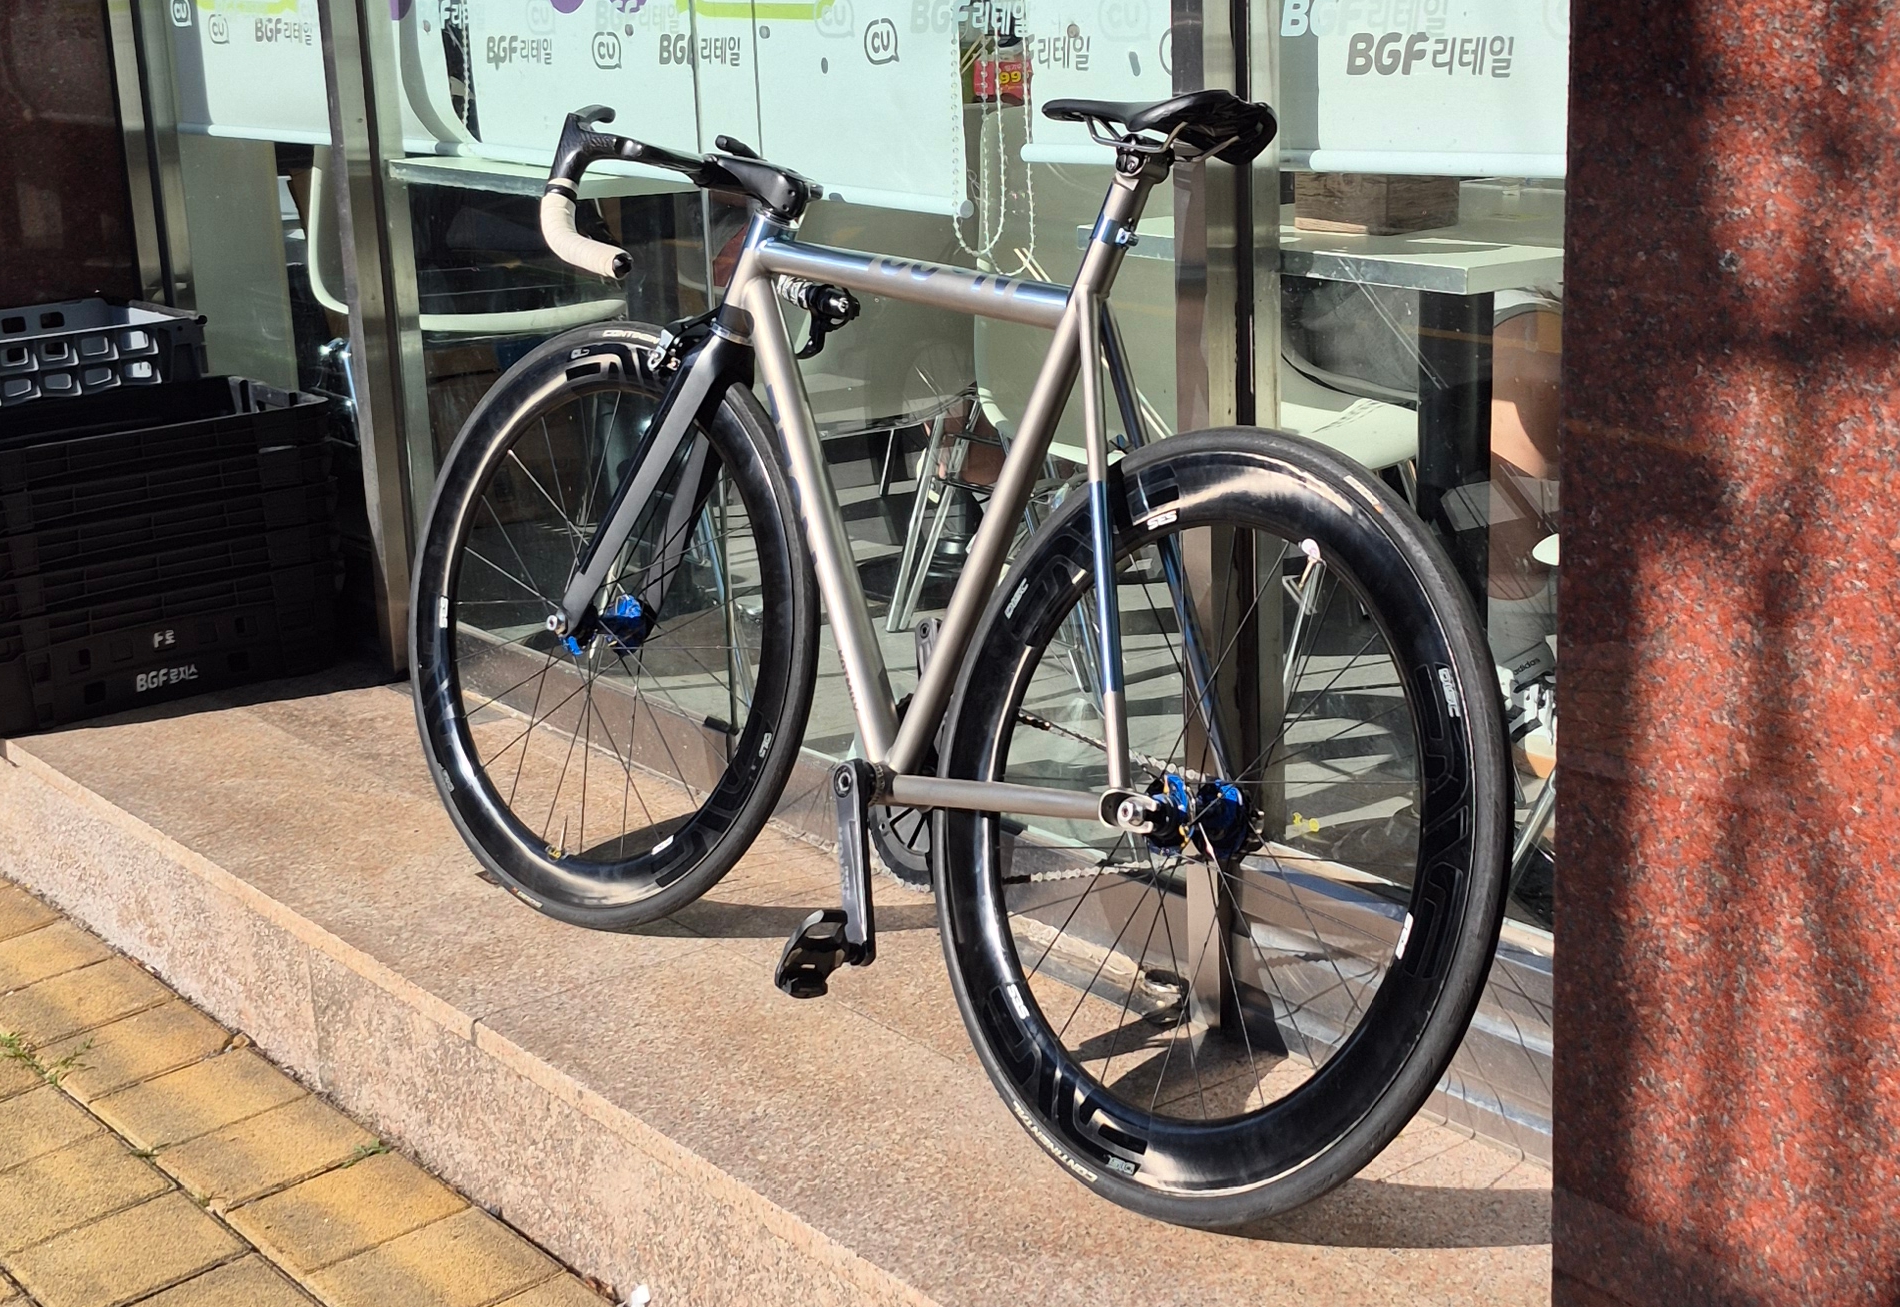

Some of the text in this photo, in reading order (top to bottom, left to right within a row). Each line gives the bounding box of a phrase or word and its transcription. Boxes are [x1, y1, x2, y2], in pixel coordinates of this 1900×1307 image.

[254, 17, 312, 46] BGF리테일
[486, 35, 553, 65] BGF리테일
[1346, 32, 1515, 79] BGF리테일
[136, 663, 199, 692] BGF로지스
[1512, 656, 1541, 675] adidas
[1012, 1100, 1099, 1184] CONTINENTAL
